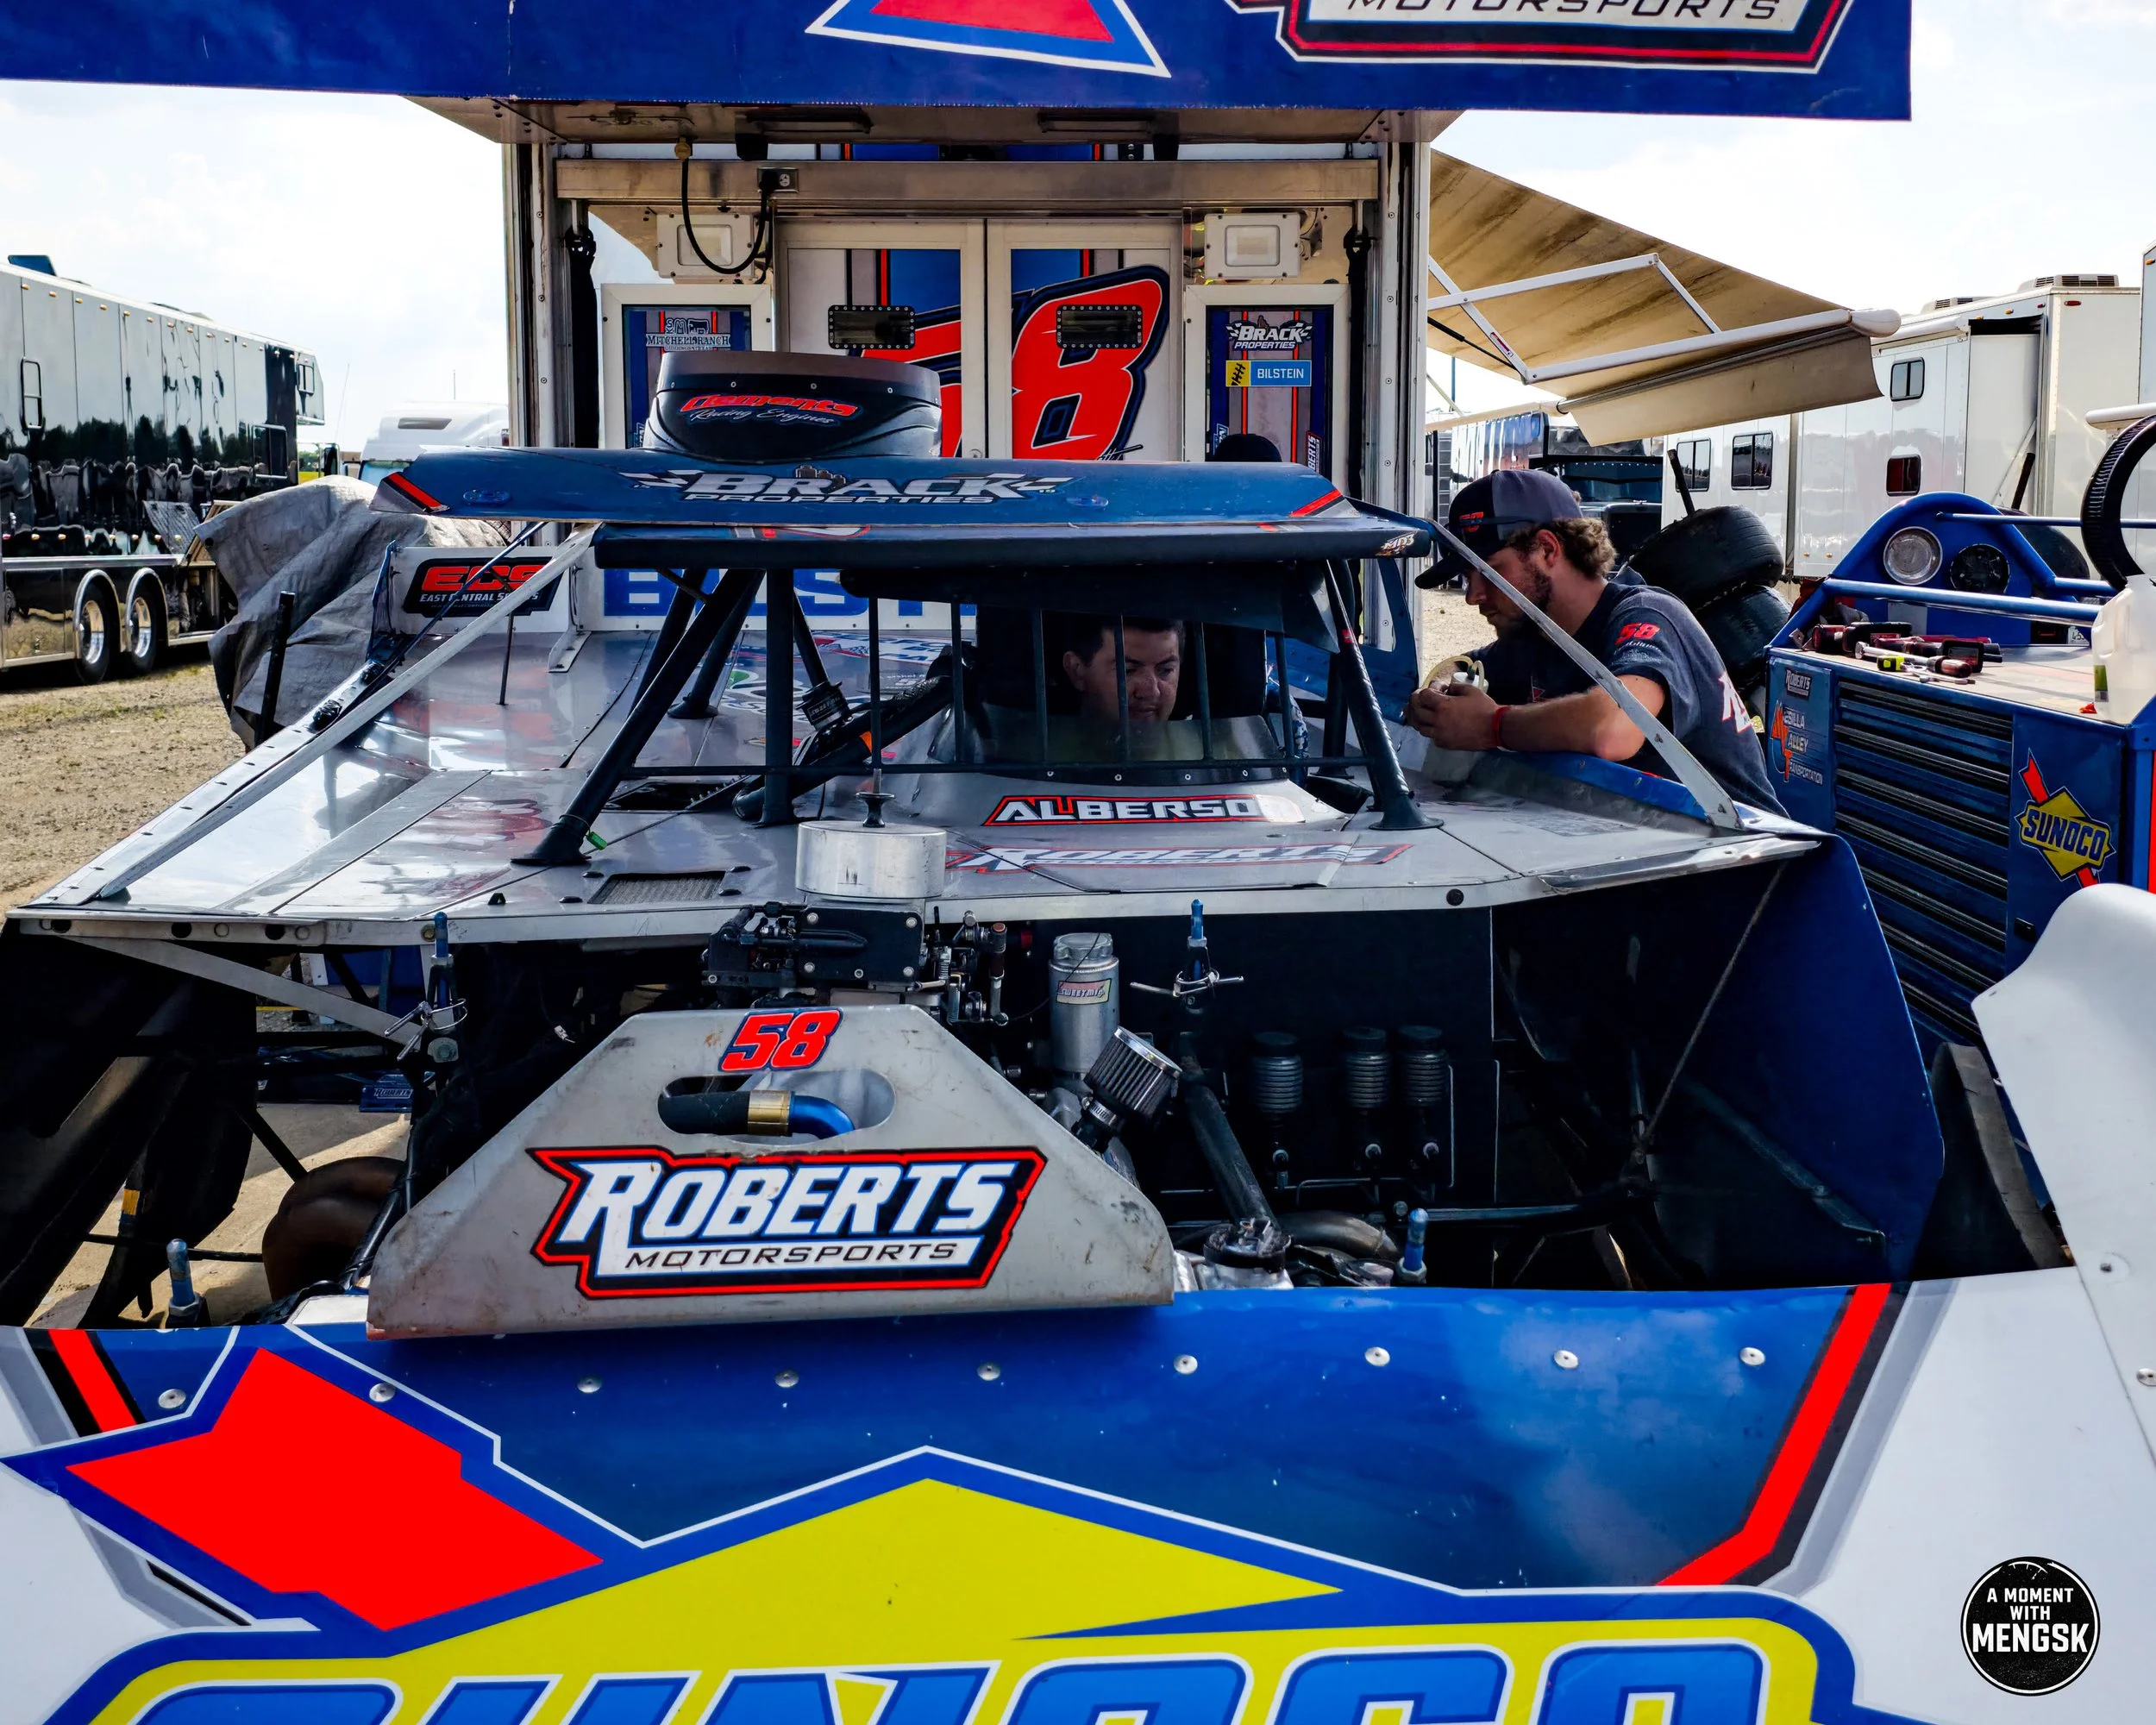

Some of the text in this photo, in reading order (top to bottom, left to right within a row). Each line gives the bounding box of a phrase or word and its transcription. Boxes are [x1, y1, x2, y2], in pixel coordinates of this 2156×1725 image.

[1238, 326, 1302, 342] BRACK
[1257, 368, 1304, 379] BILSTEIN
[690, 409, 834, 424] Racing Engines
[683, 474, 1028, 499] BRACK
[684, 493, 994, 504] PROPERTIES
[420, 593, 445, 602] EAST
[448, 593, 494, 602] CNTRAL
[1614, 622, 1660, 645] 58
[1786, 670, 1810, 691] ROBERTS
[995, 798, 1294, 821] ALBERSO
[2024, 808, 2106, 861] SUNOCO
[721, 1009, 843, 1071] 58
[559, 1161, 1017, 1244] ROBERTS
[625, 1242, 958, 1270] MOTORSPORTS
